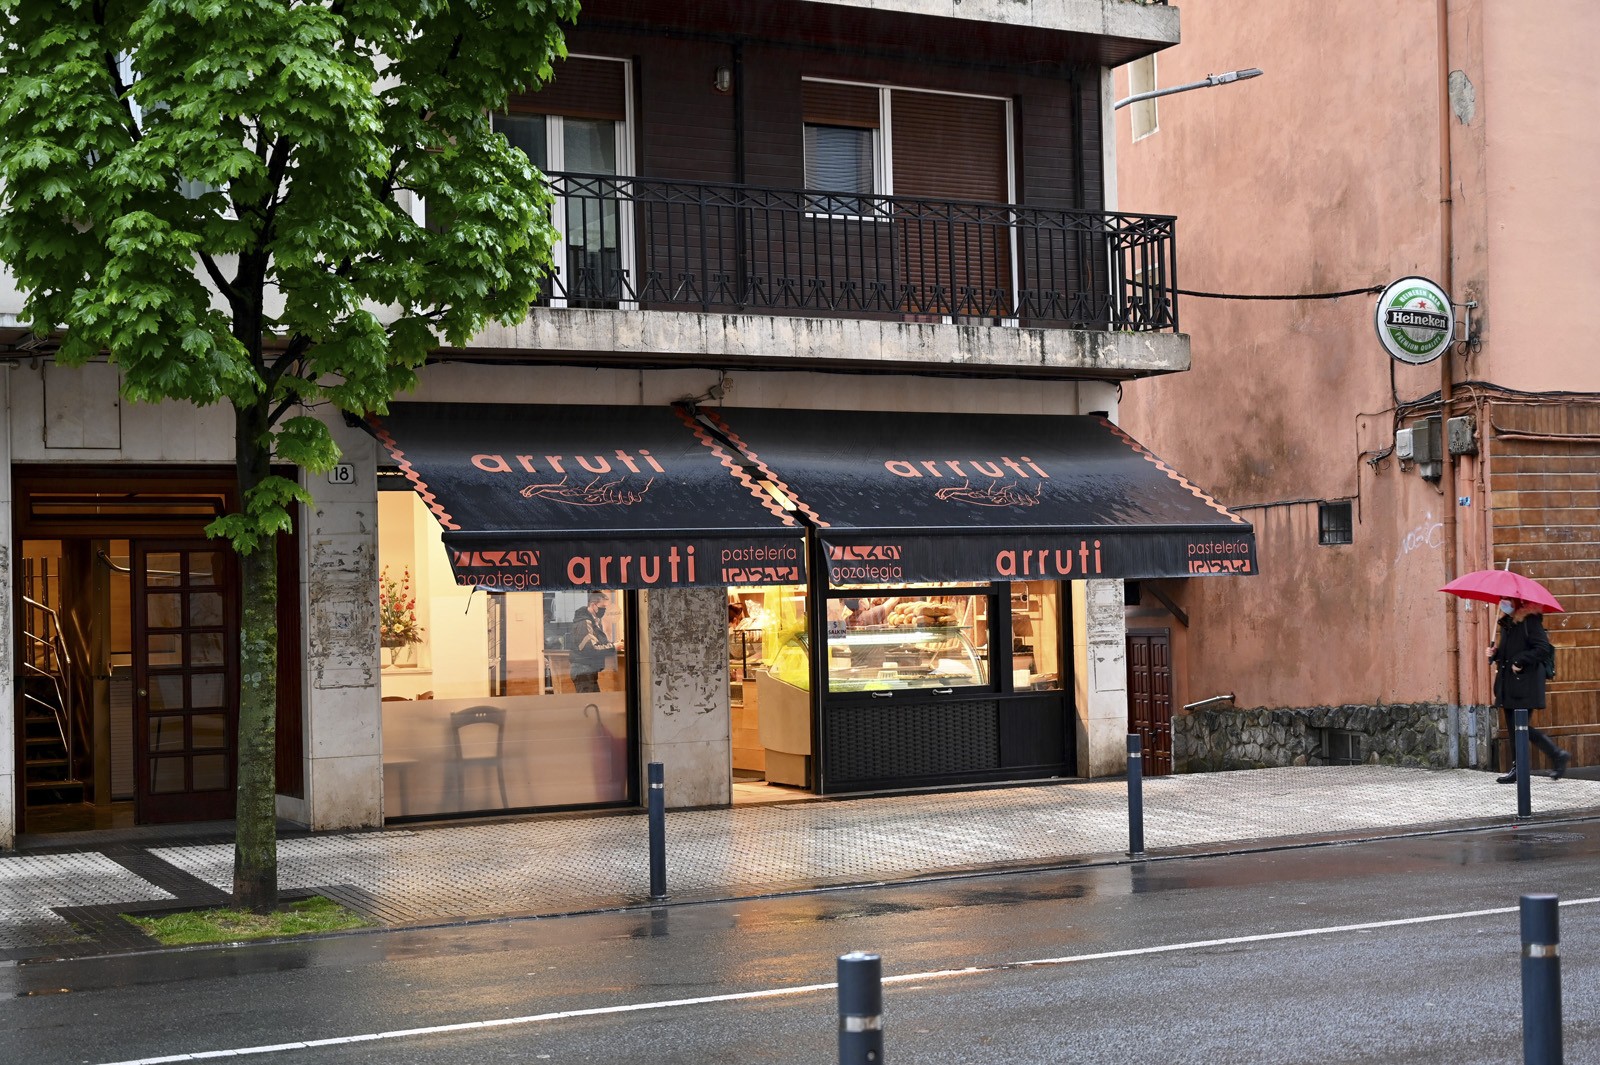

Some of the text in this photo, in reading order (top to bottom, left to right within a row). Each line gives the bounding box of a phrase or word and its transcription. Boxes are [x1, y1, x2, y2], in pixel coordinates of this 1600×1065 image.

[1398, 290, 1427, 303] HEINEKEN
[1392, 311, 1446, 328] Heineken
[1394, 331, 1419, 351] PREMIUM
[1420, 336, 1441, 351] QUALITY
[470, 448, 665, 474] arruti
[884, 455, 1050, 478] arruti
[333, 466, 349, 481] 18
[721, 543, 797, 564] pastelería
[995, 540, 1103, 577] arruti
[1187, 539, 1249, 558] pastelería
[566, 545, 696, 586] arruti
[832, 563, 902, 582] gozotegia
